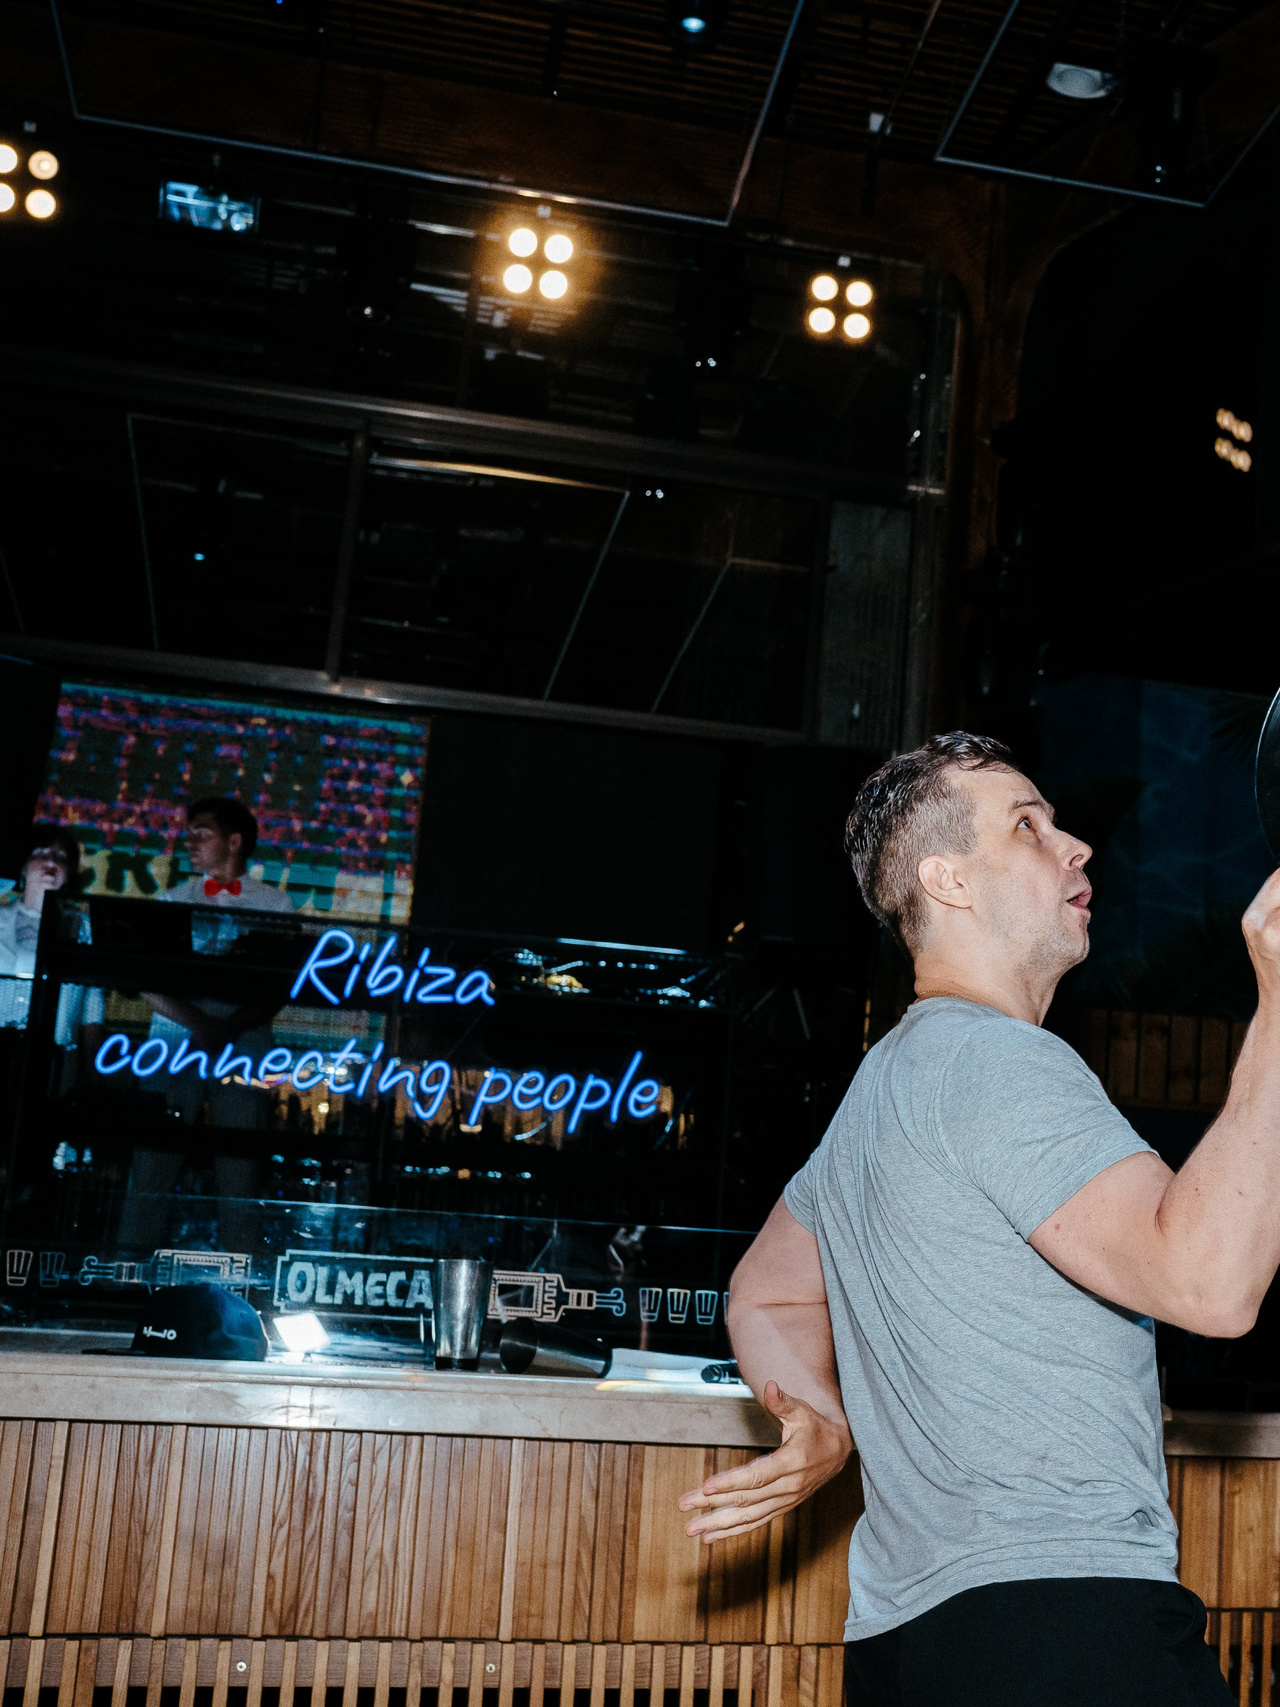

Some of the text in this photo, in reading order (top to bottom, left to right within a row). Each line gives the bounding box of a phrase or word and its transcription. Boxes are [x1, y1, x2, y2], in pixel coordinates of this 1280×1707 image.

[290, 928, 496, 1007] Ribiza
[93, 1032, 661, 1134] connecting people
[286, 1262, 435, 1310] OLMECA
